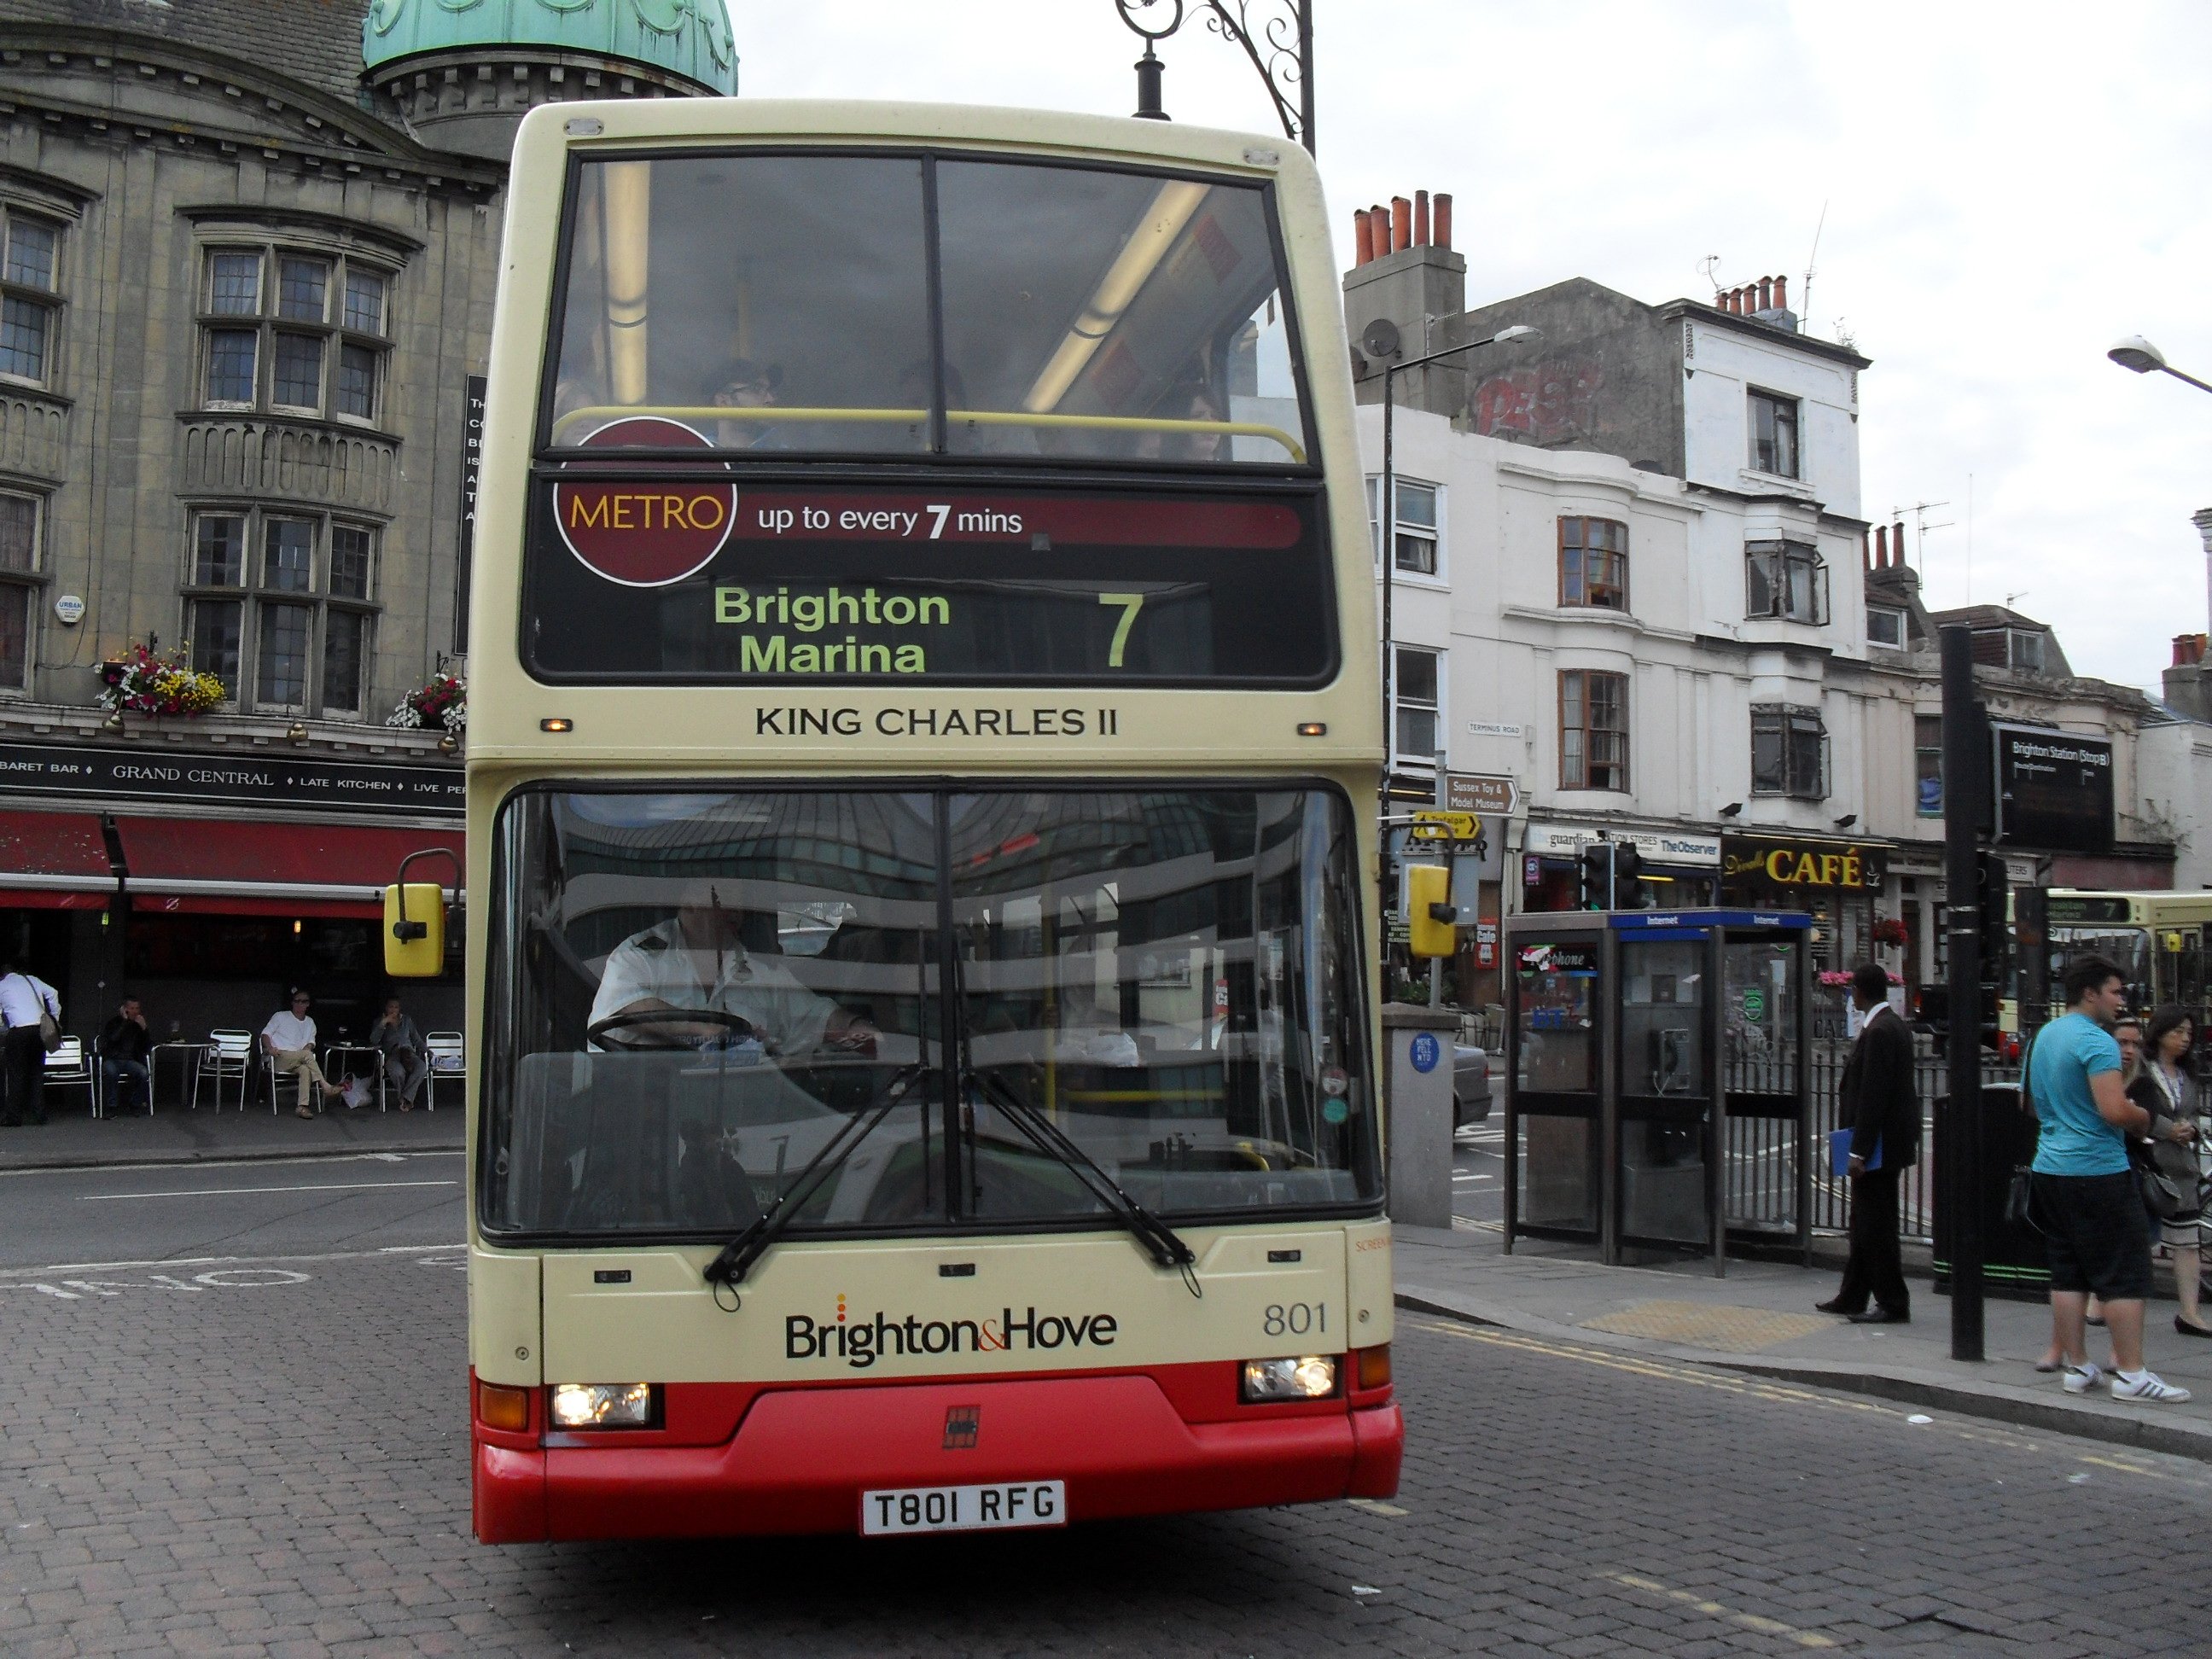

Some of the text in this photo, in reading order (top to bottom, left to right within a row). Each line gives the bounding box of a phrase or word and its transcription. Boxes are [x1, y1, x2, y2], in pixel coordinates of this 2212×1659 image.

[570, 494, 724, 530] METRO
[759, 504, 1023, 539] up to every 7 mins
[715, 586, 1144, 667] Brighton 7
[741, 635, 926, 672] Marina
[755, 707, 1118, 736] KING CHARLES II
[1470, 724, 1500, 732] TERMINUS
[2012, 741, 2049, 758] Brighton
[2049, 745, 2079, 762] Station
[50, 764, 79, 774] BAR
[113, 765, 275, 787] GRAND CENTRAL
[300, 777, 392, 791] LATE KITCHEN
[414, 783, 440, 794] LIVE
[1453, 781, 1503, 795] Sussex Toy &
[1451, 796, 1505, 810] Model Museum
[1431, 816, 1467, 825] Trafalgar
[1550, 832, 1596, 847] guardian
[1630, 835, 1658, 847] STORES
[1767, 847, 1863, 888] CAFÉ
[1646, 915, 1780, 926] Internet Internet
[1264, 1302, 1324, 1336] 801
[875, 1485, 1054, 1527] T801 RFG
